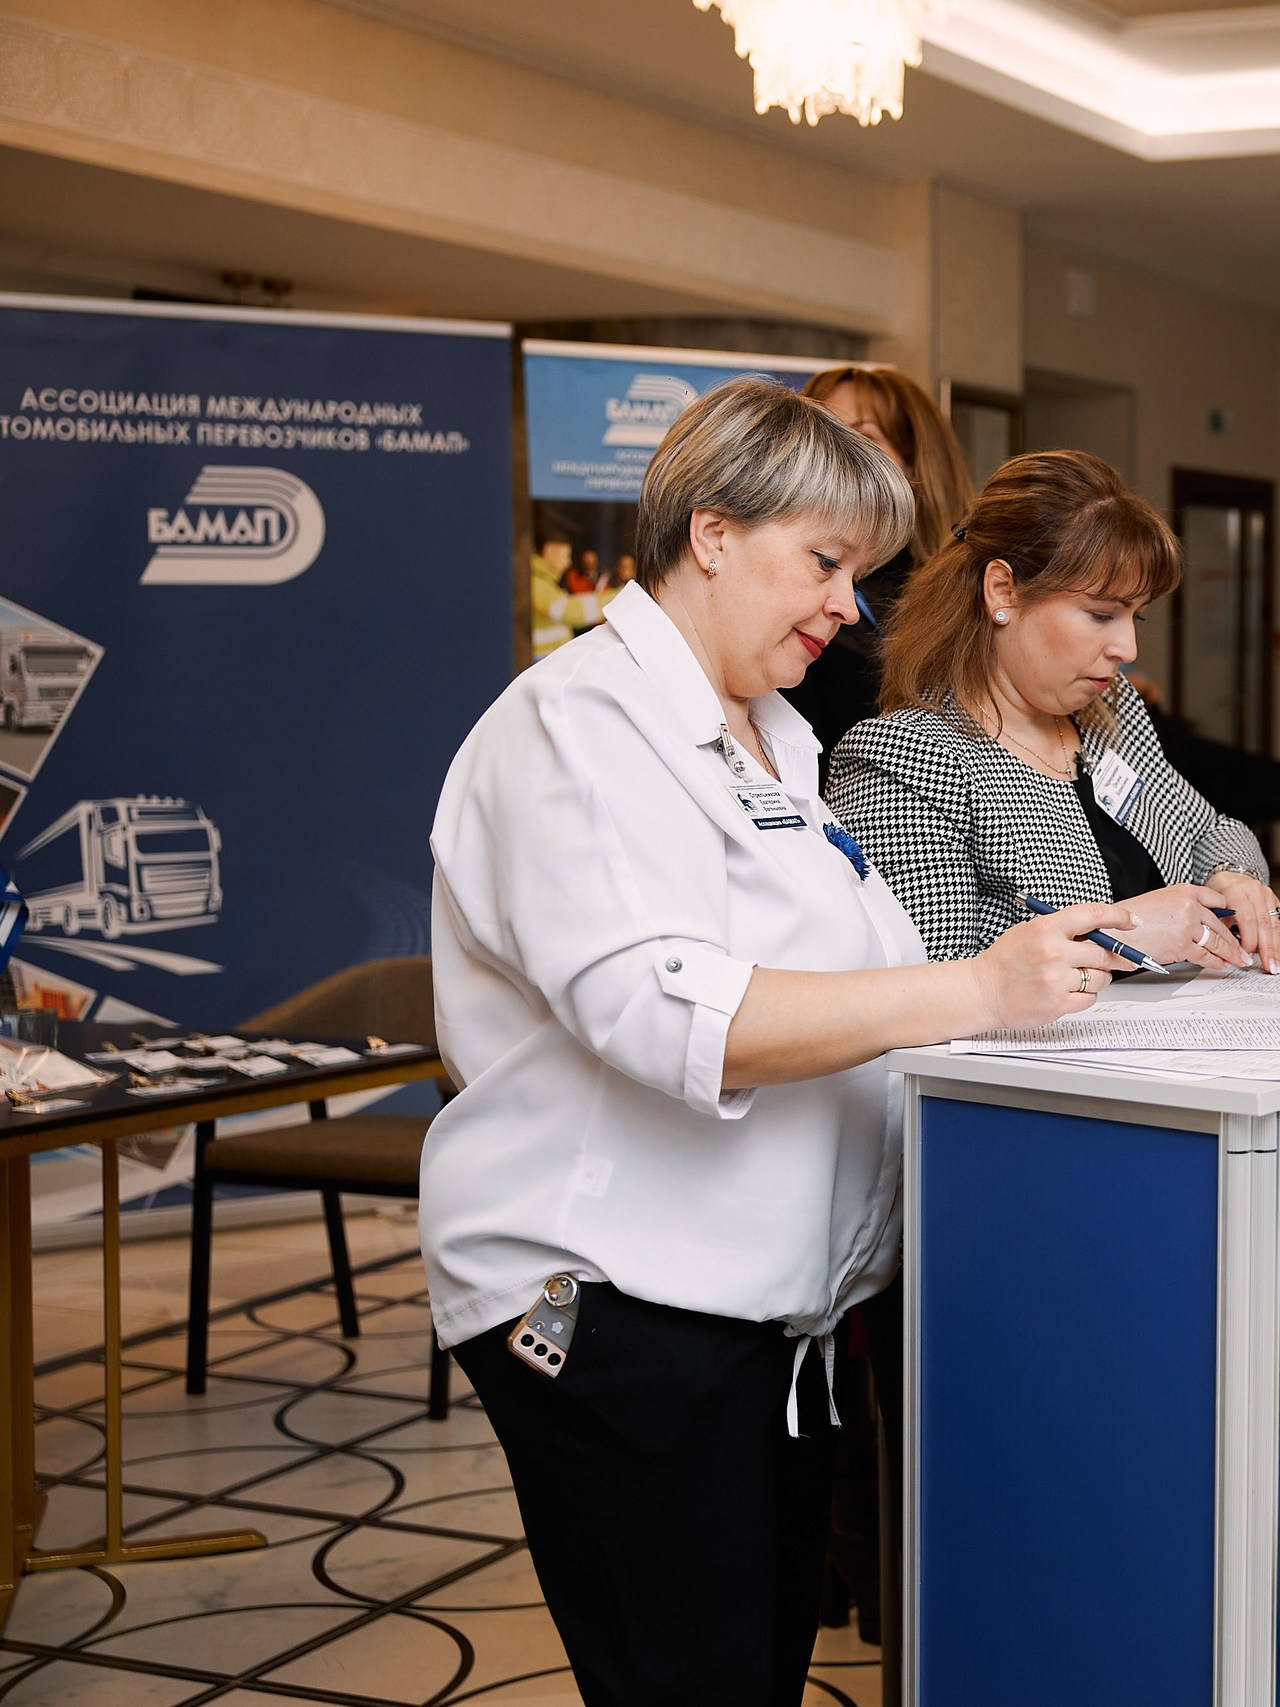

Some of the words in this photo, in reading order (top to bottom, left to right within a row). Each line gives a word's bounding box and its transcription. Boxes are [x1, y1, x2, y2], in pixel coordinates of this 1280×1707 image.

[20, 386, 201, 418] АССОЦИАЦИЯ
[206, 394, 424, 426] МЕЖДУНАРОДНЫХ
[197, 422, 370, 451] ПЕРЕВОЗЧИКОВ
[147, 508, 283, 545] БАМАП
